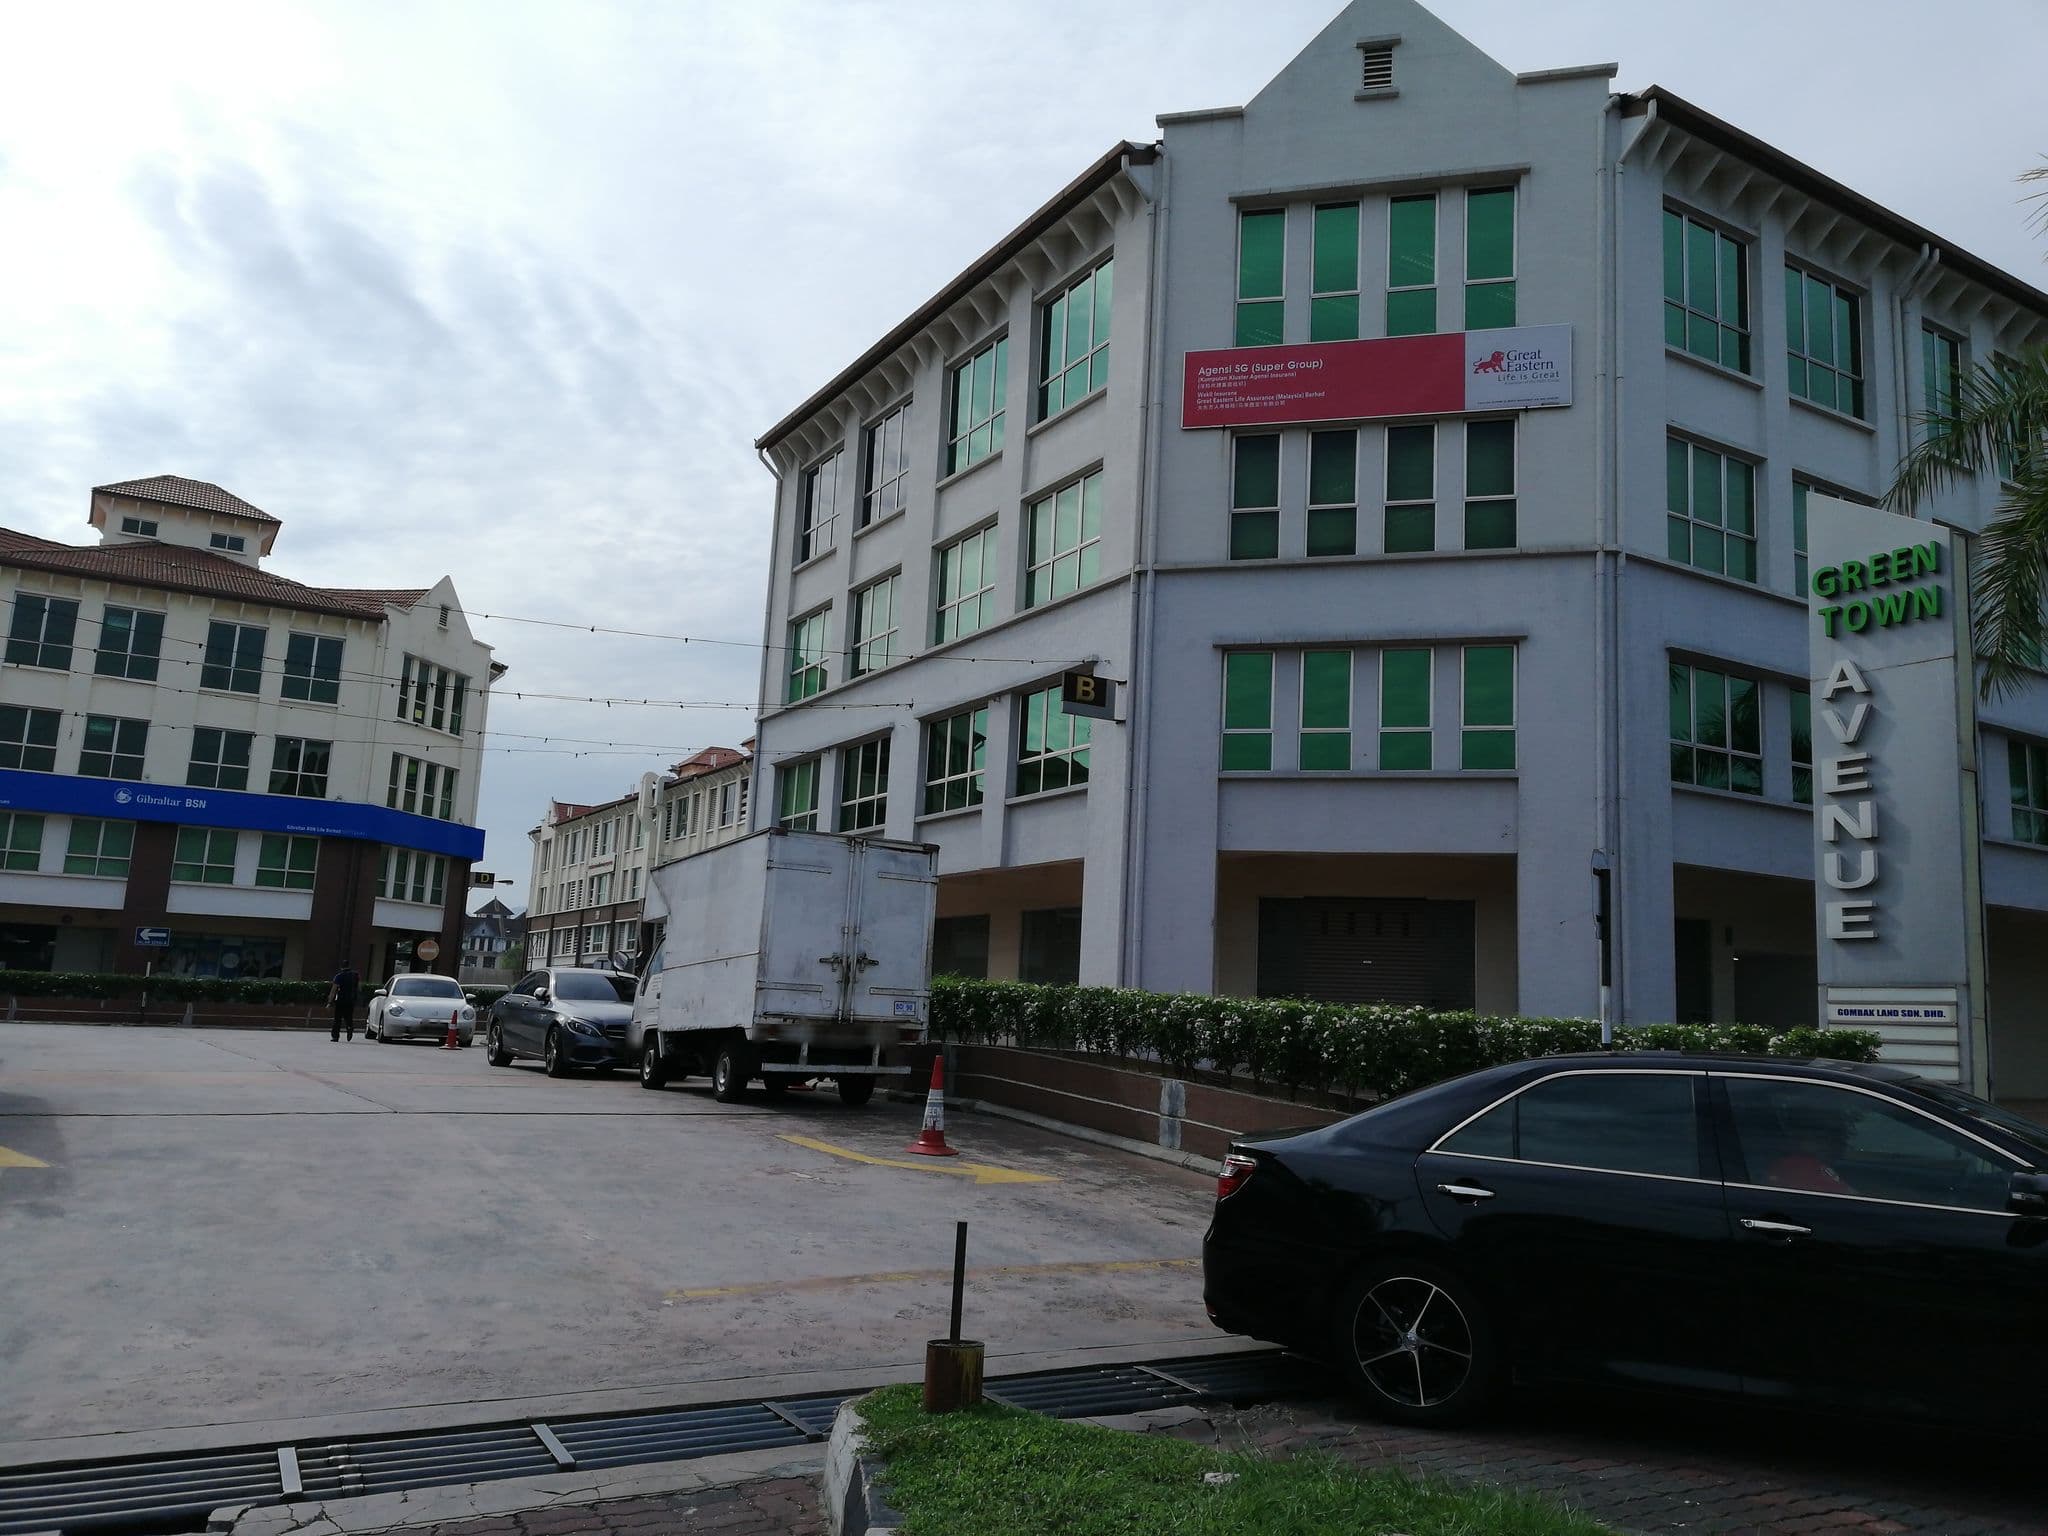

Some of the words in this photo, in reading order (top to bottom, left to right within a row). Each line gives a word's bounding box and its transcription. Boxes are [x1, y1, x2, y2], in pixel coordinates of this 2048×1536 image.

[1506, 349, 1542, 361] Great
[1198, 365, 1232, 376] Agensi
[1234, 364, 1249, 373] SG
[1251, 362, 1285, 374] (Super
[1287, 359, 1323, 370] Group)
[1507, 360, 1554, 372] Eastern
[1497, 373, 1516, 382] Life
[1520, 372, 1528, 380] is
[1532, 371, 1559, 379] Great
[1275, 393, 1305, 401] (Malaysia)
[1812, 541, 1940, 598] GREEN
[1817, 584, 1943, 638] TOWN
[1076, 675, 1095, 702] B
[136, 794, 181, 807] Gibraltar
[185, 798, 207, 809] BSN
[1822, 658, 1879, 940] AVENUE
[481, 873, 490, 883] D
[1837, 1008, 1875, 1017] GOMBAK
[1876, 1008, 1899, 1017] LAND
[1900, 1009, 1922, 1018] SDN.
[1923, 1009, 1946, 1018] BHD.
